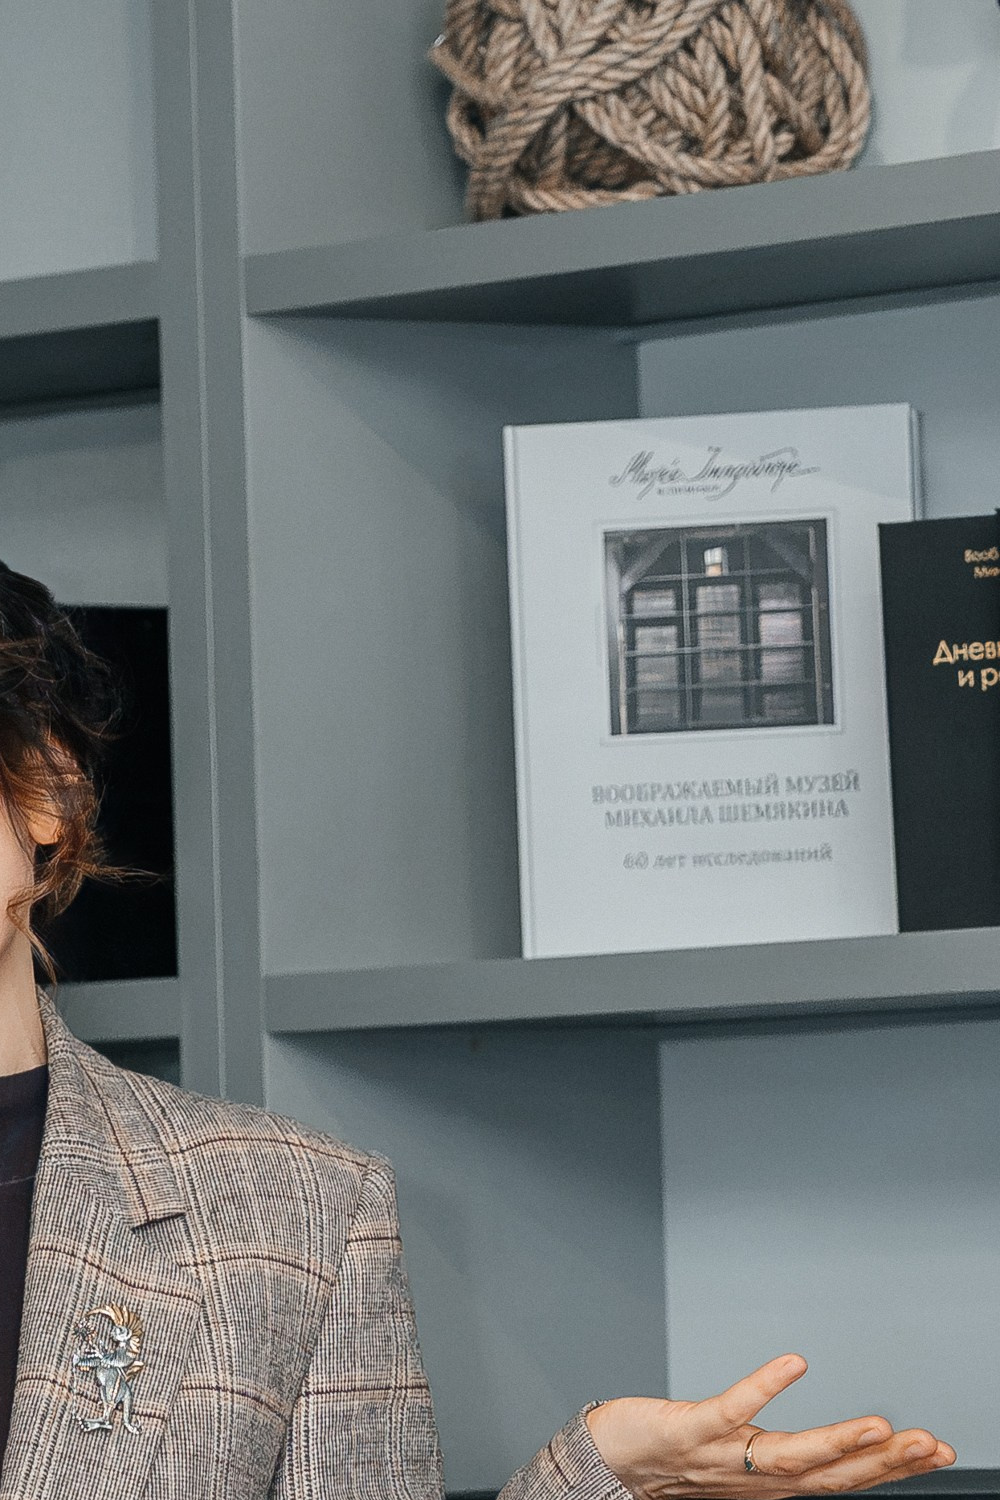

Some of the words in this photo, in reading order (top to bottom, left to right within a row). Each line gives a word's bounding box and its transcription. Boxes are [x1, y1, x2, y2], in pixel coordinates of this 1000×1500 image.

[957, 669, 975, 688] и
[980, 667, 1000, 692] р
[591, 772, 780, 804] ВООБРАЖАЕМЫЙ
[785, 768, 861, 793] МУЗЕЙ
[604, 803, 714, 829] МИХАИЛА
[717, 798, 849, 824] ШЕМЯКИНА
